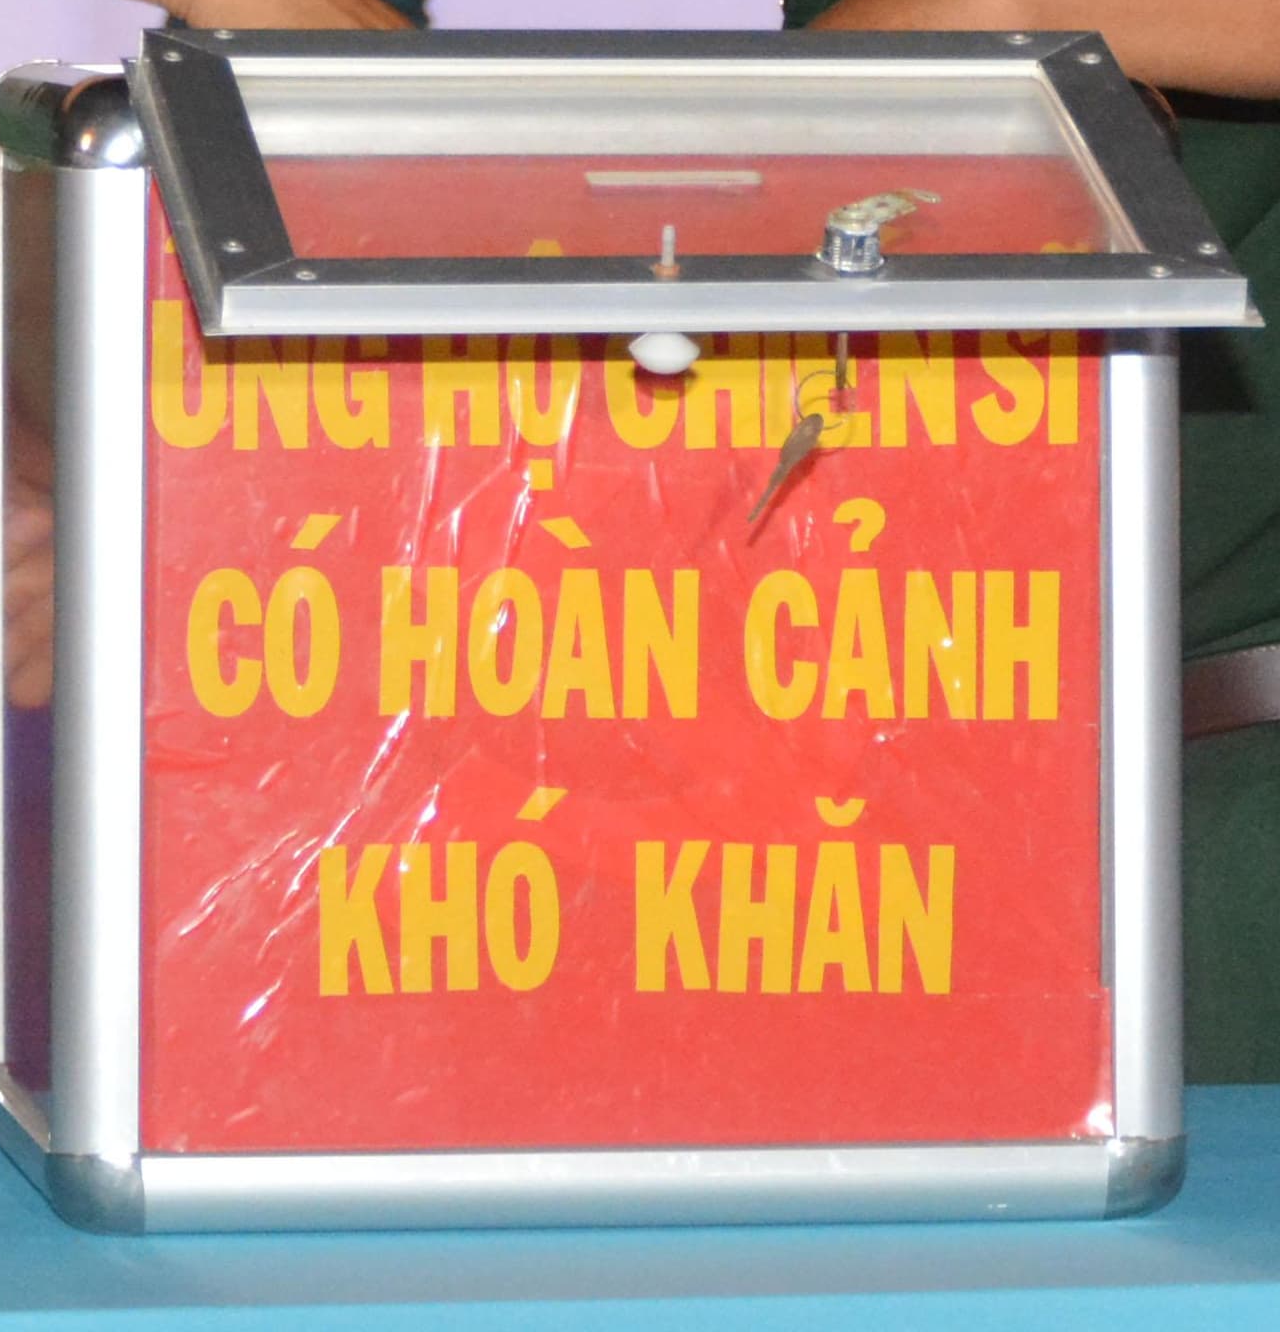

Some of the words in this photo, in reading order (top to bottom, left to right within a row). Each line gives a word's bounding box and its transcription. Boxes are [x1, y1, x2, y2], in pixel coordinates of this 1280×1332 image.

[186, 513, 342, 718] CÓ
[379, 516, 700, 720] HOÀN
[743, 496, 1061, 721] CẢNH
[319, 786, 566, 997] KHÓ
[635, 796, 956, 996] KHĂN
